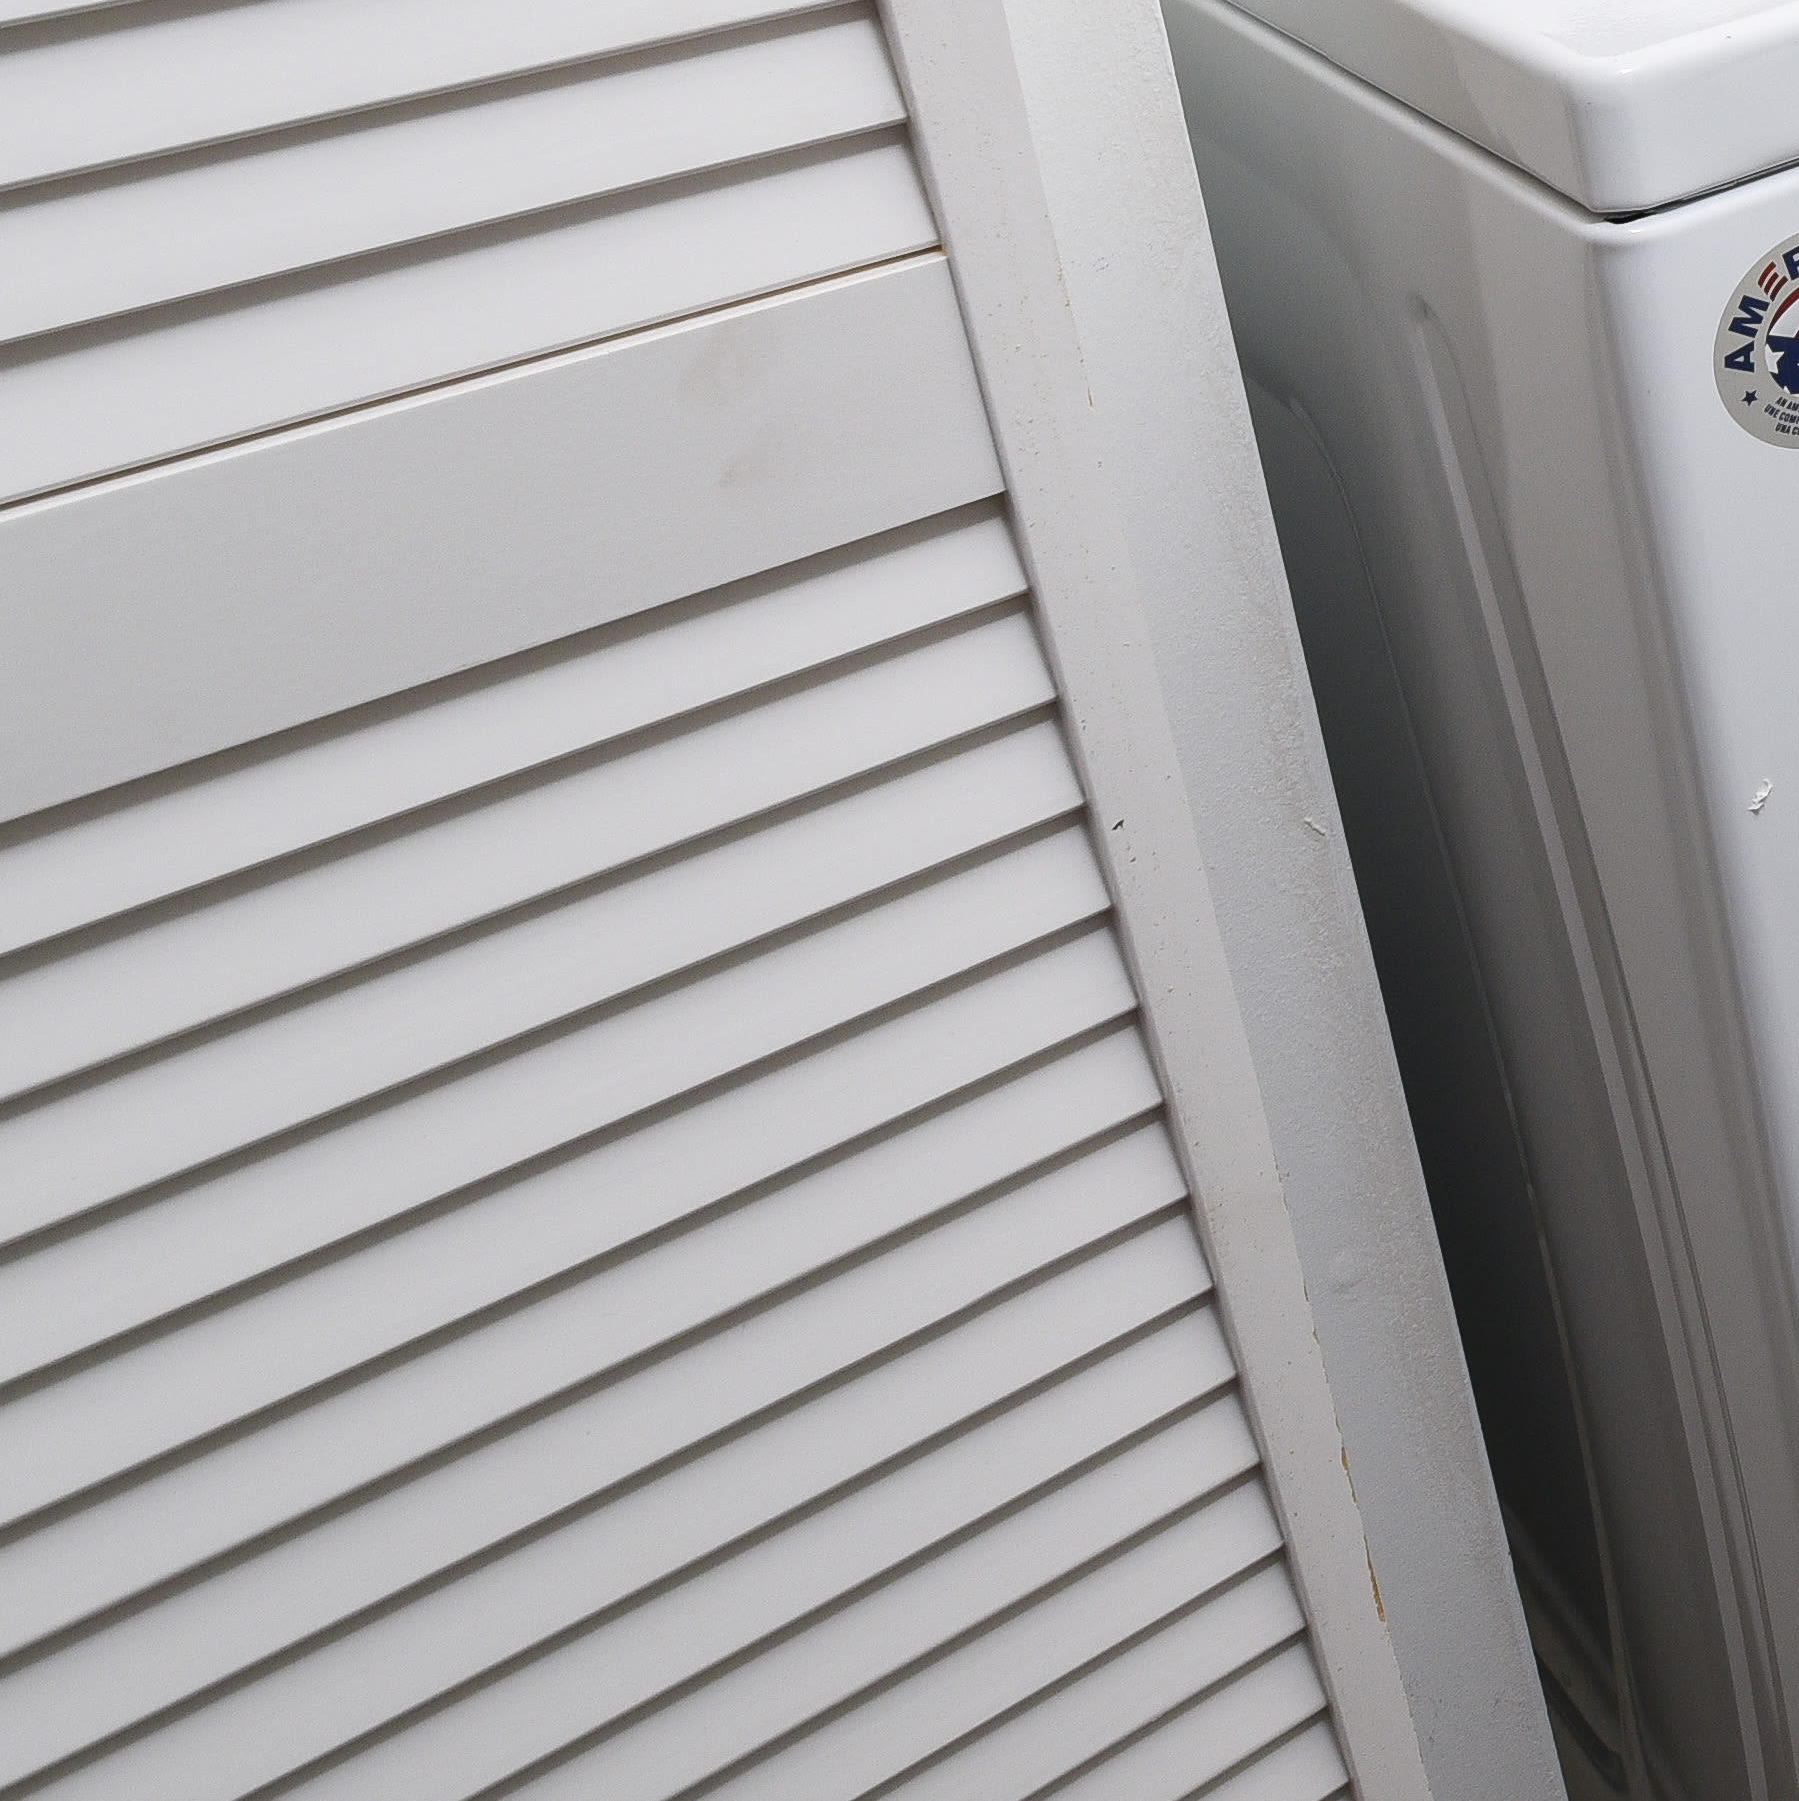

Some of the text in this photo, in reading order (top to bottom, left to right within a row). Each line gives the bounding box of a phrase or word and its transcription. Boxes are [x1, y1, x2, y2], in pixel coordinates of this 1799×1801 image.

[1775, 396, 1788, 407] AN
[1764, 403, 1780, 418] UNE
[1775, 422, 1791, 434] UNA
